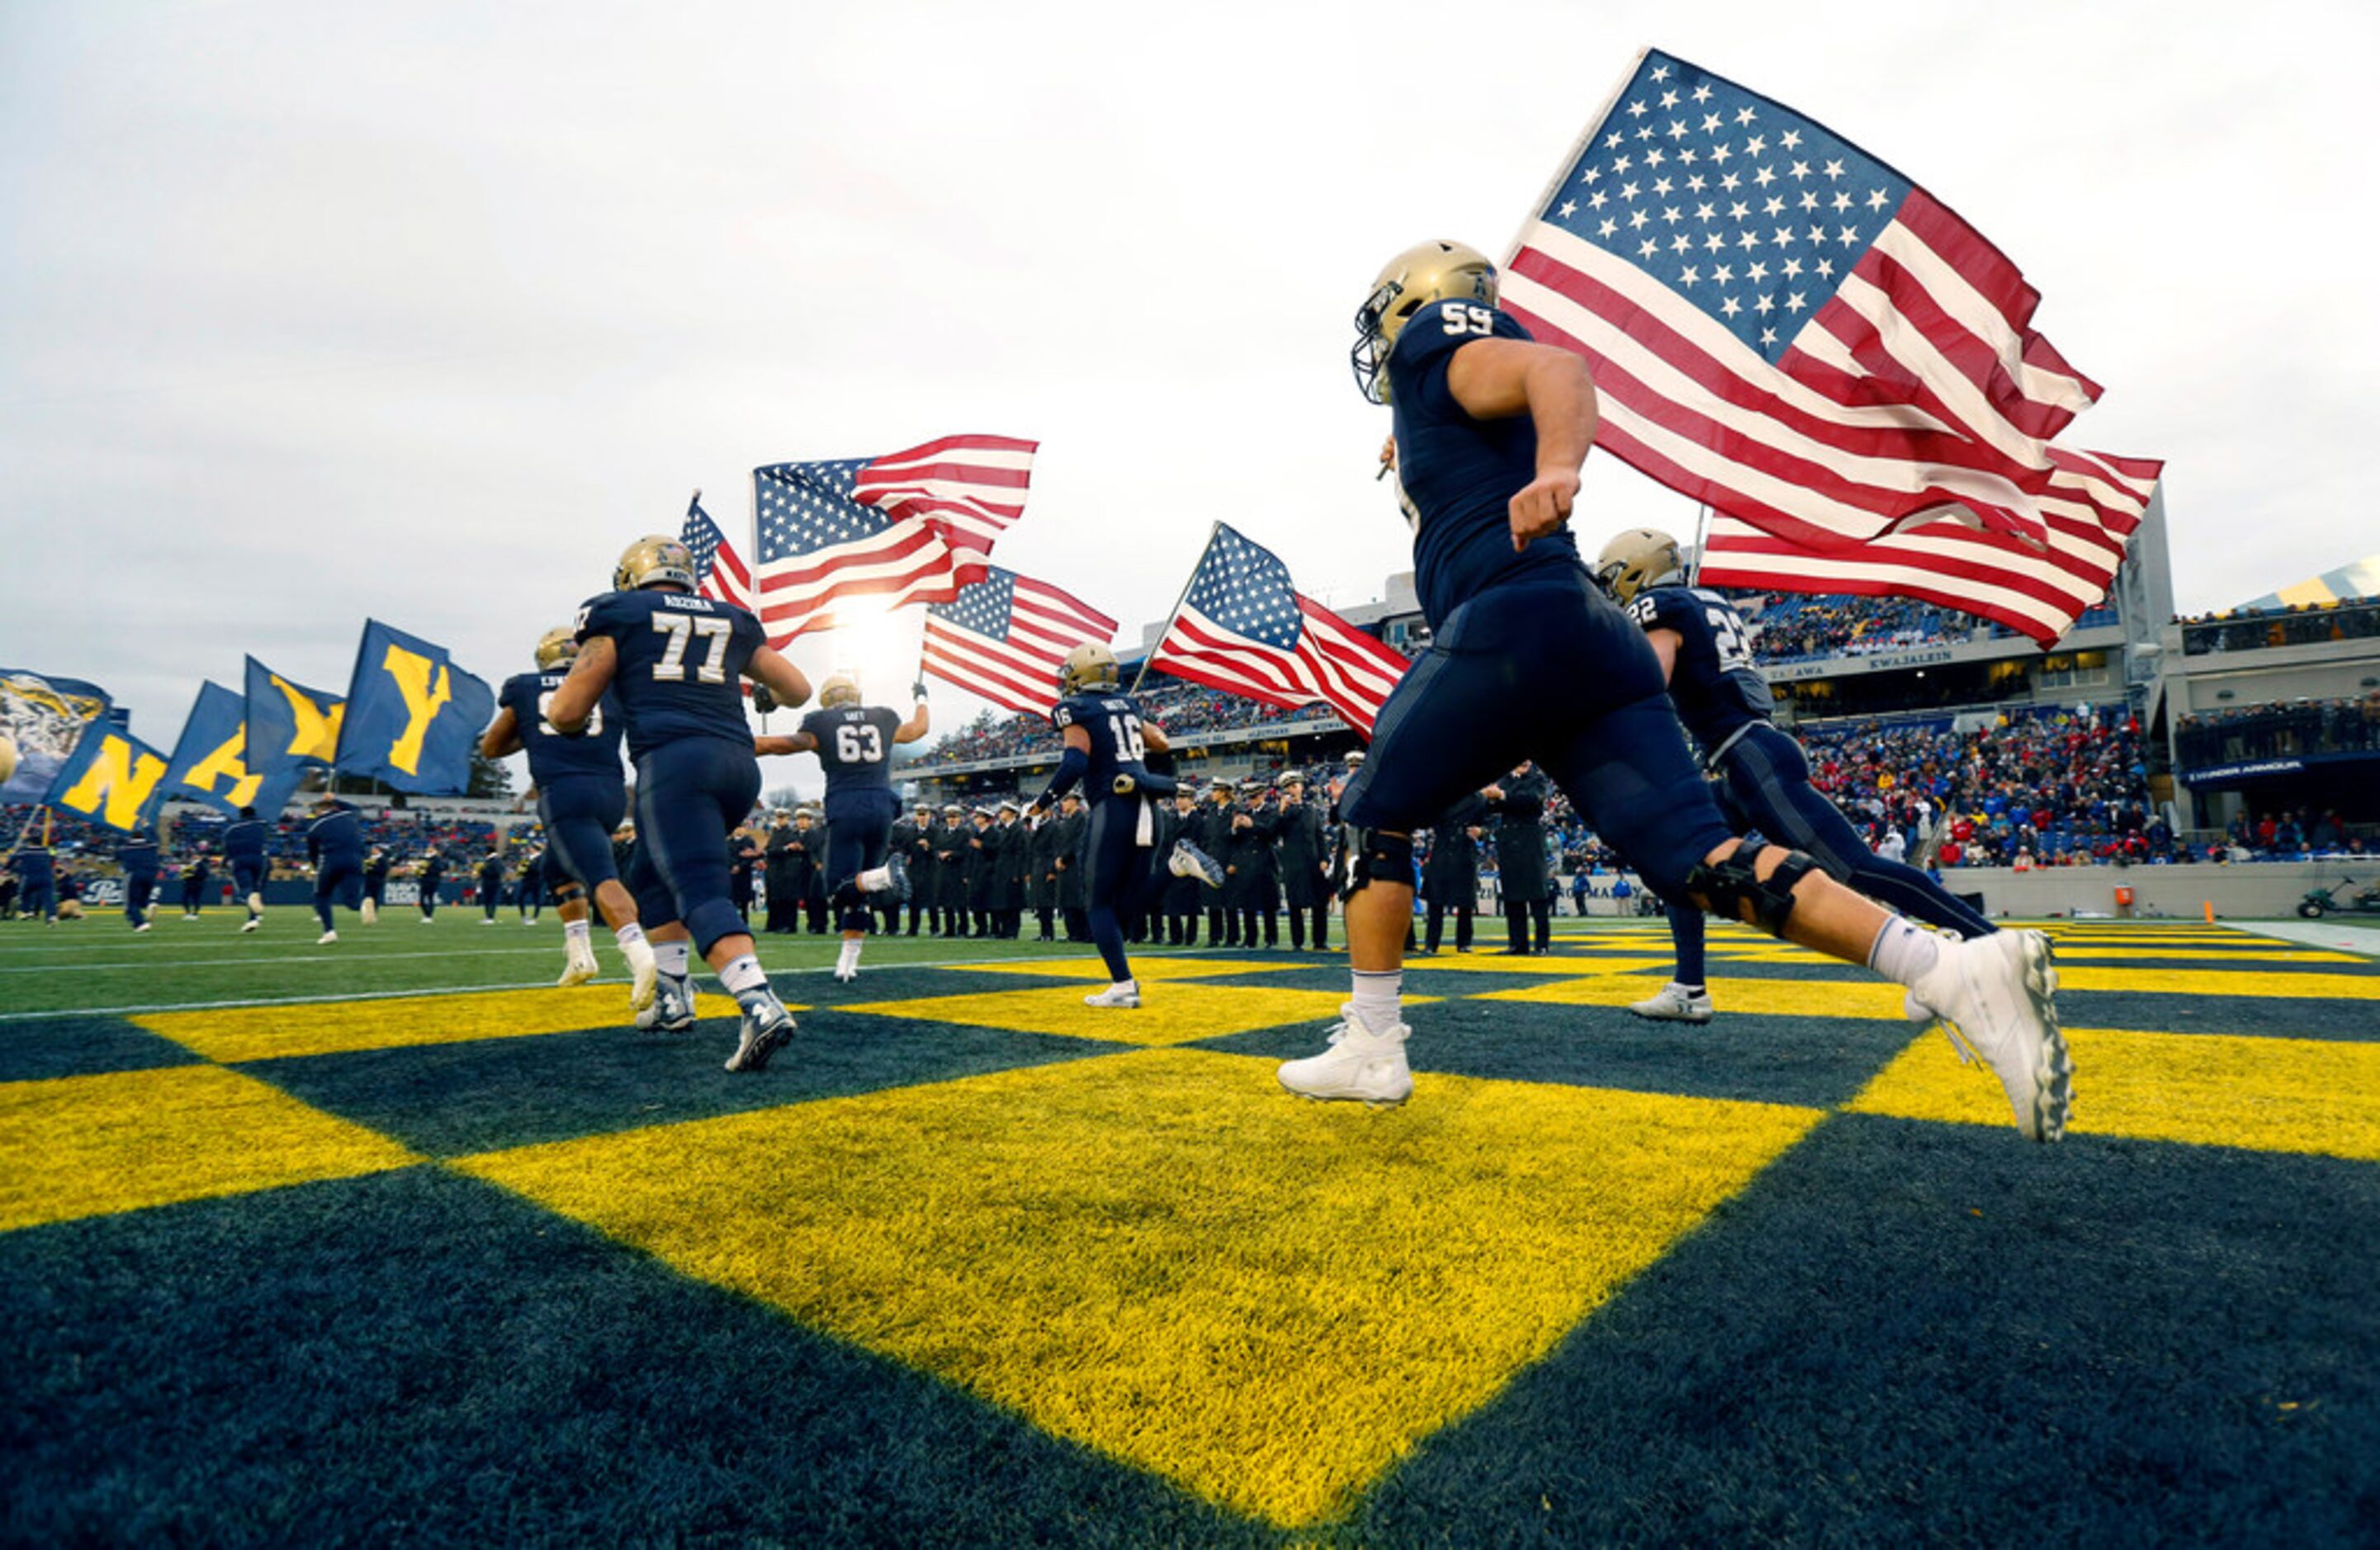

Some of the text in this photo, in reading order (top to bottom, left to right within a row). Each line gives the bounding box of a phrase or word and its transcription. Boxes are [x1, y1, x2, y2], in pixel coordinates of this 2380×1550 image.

[1441, 303, 1493, 335] 59
[651, 611, 732, 684] 77
[1870, 650, 1952, 670] KWAJALEIN
[1054, 706, 1072, 727] 16
[60, 735, 168, 832] N
[383, 643, 452, 777] Y
[836, 725, 882, 763] 63
[1109, 713, 1144, 762] 16
